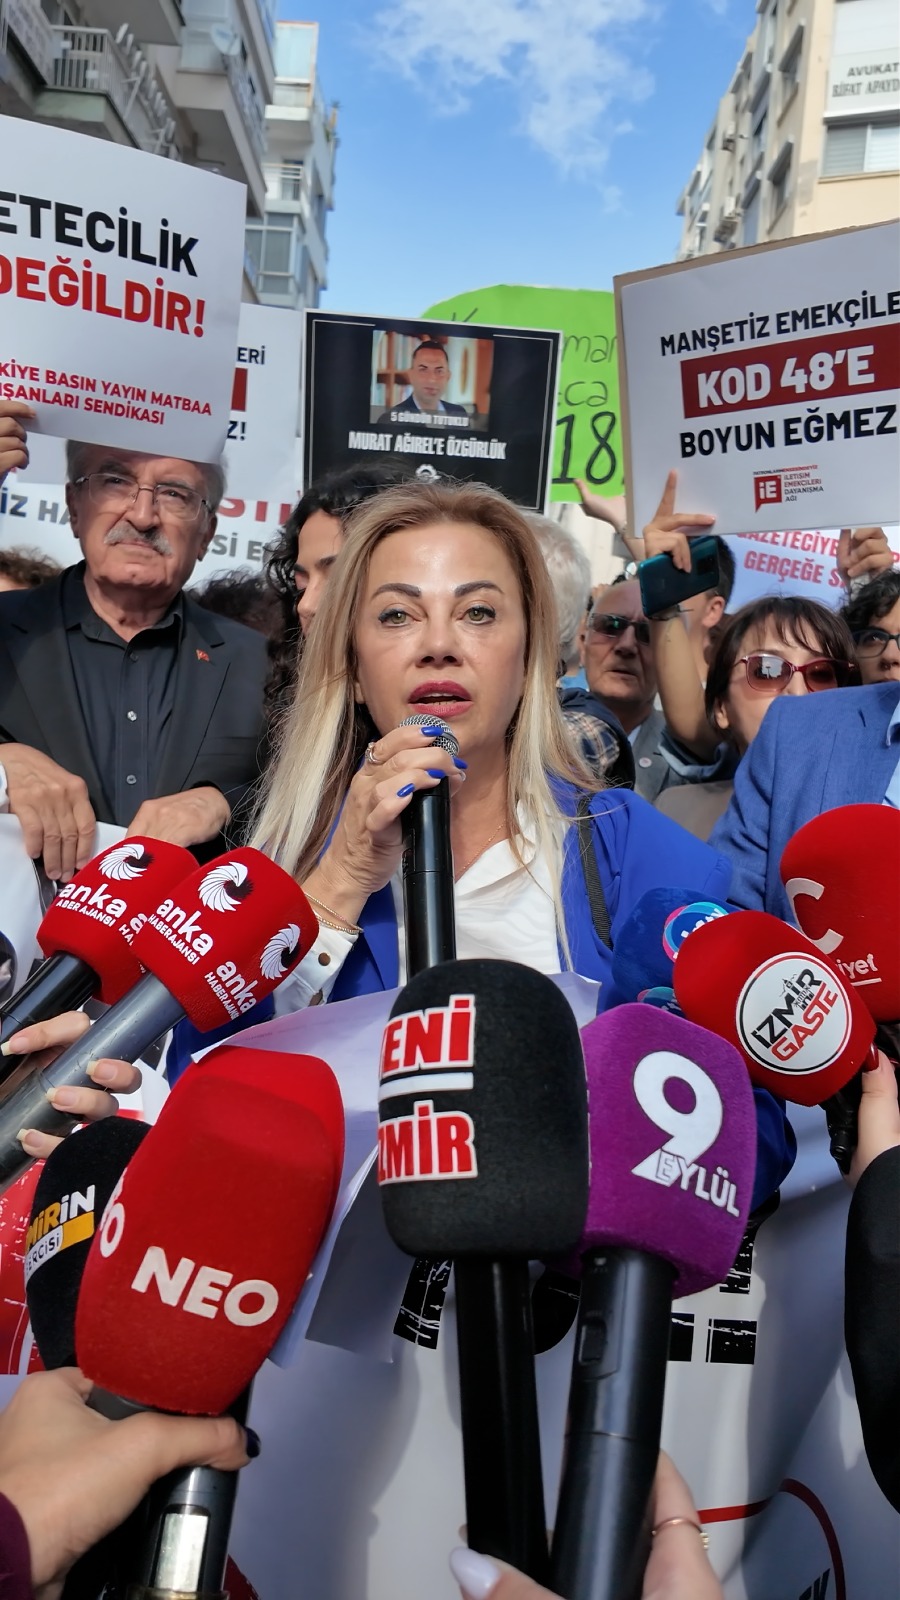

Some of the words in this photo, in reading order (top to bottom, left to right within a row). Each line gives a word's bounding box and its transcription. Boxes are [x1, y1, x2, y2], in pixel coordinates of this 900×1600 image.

[660, 311, 770, 356] MANŞETİZ
[776, 290, 900, 335] EMEKÇİLE
[237, 346, 265, 365] ERİ
[697, 363, 771, 409] KOD
[780, 345, 875, 394] 48'E
[0, 358, 40, 382] KİYE
[45, 369, 97, 393] BASIN
[101, 380, 146, 402] YAYIN
[151, 391, 212, 416] MATBAA
[84, 397, 165, 425] SENDİKASI
[390, 411, 398, 422] 5
[680, 421, 775, 458] BOYUN
[784, 405, 897, 446] EĞMEZ
[348, 431, 393, 451] MURAT
[447, 436, 507, 459] ÖZGÜRLÜK
[737, 531, 839, 557] AZETECİYE
[743, 550, 824, 583] GERÇEĞE
[59, 883, 127, 918] anka
[156, 899, 214, 956] anka
[216, 961, 258, 1014] anka
[380, 994, 476, 1078] ENİ
[770, 981, 839, 1062] GASTE
[655, 1149, 740, 1218] EYLÜL
[131, 1246, 279, 1327] NEO
